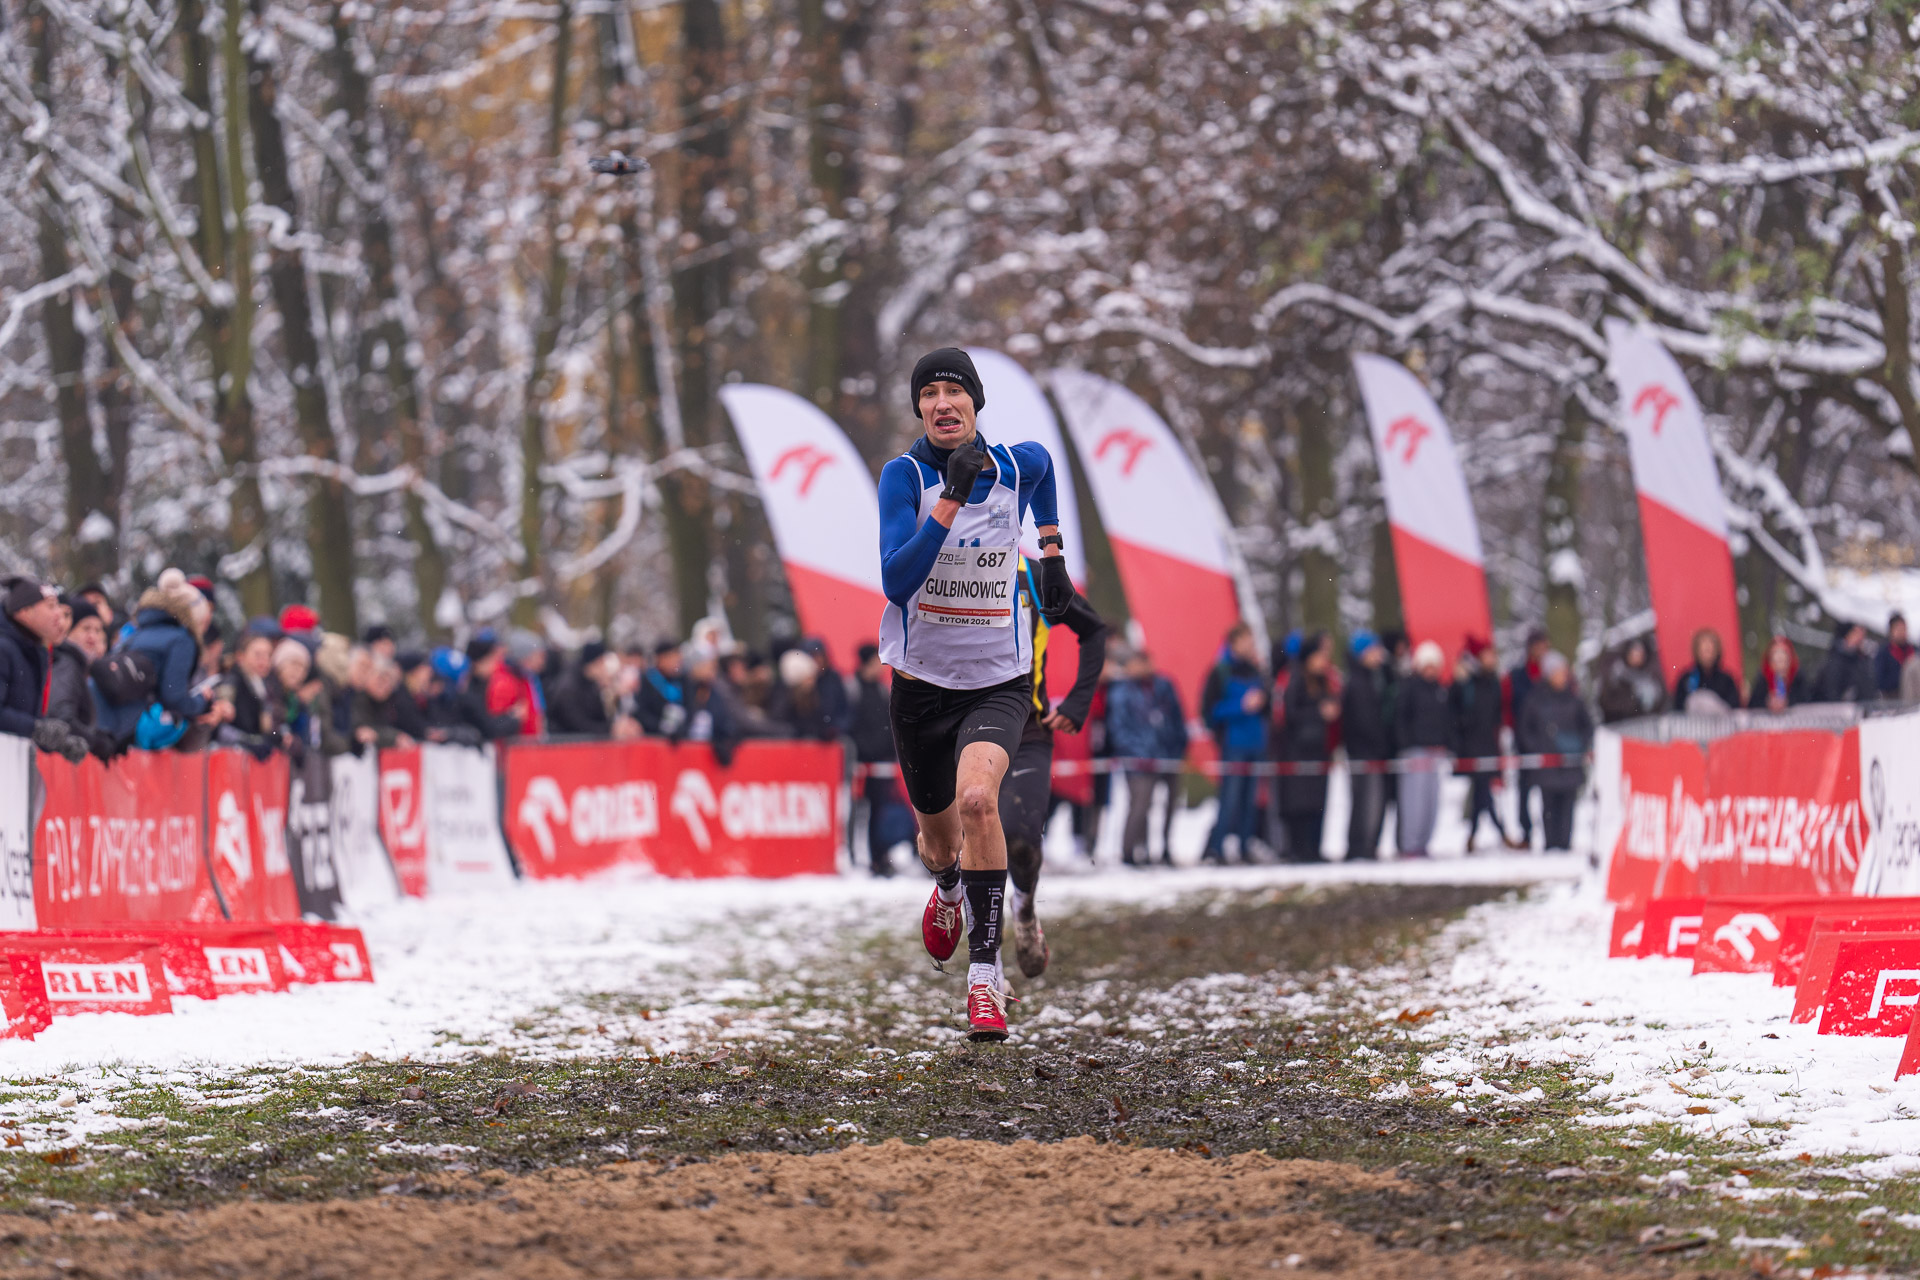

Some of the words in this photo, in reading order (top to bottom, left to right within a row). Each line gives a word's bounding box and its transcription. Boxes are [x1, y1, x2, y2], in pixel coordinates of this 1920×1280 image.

[938, 553, 953, 561] 770
[977, 552, 1007, 567] 687
[925, 578, 1007, 598] GULBINOWICZ
[939, 616, 969, 625] BYTOM
